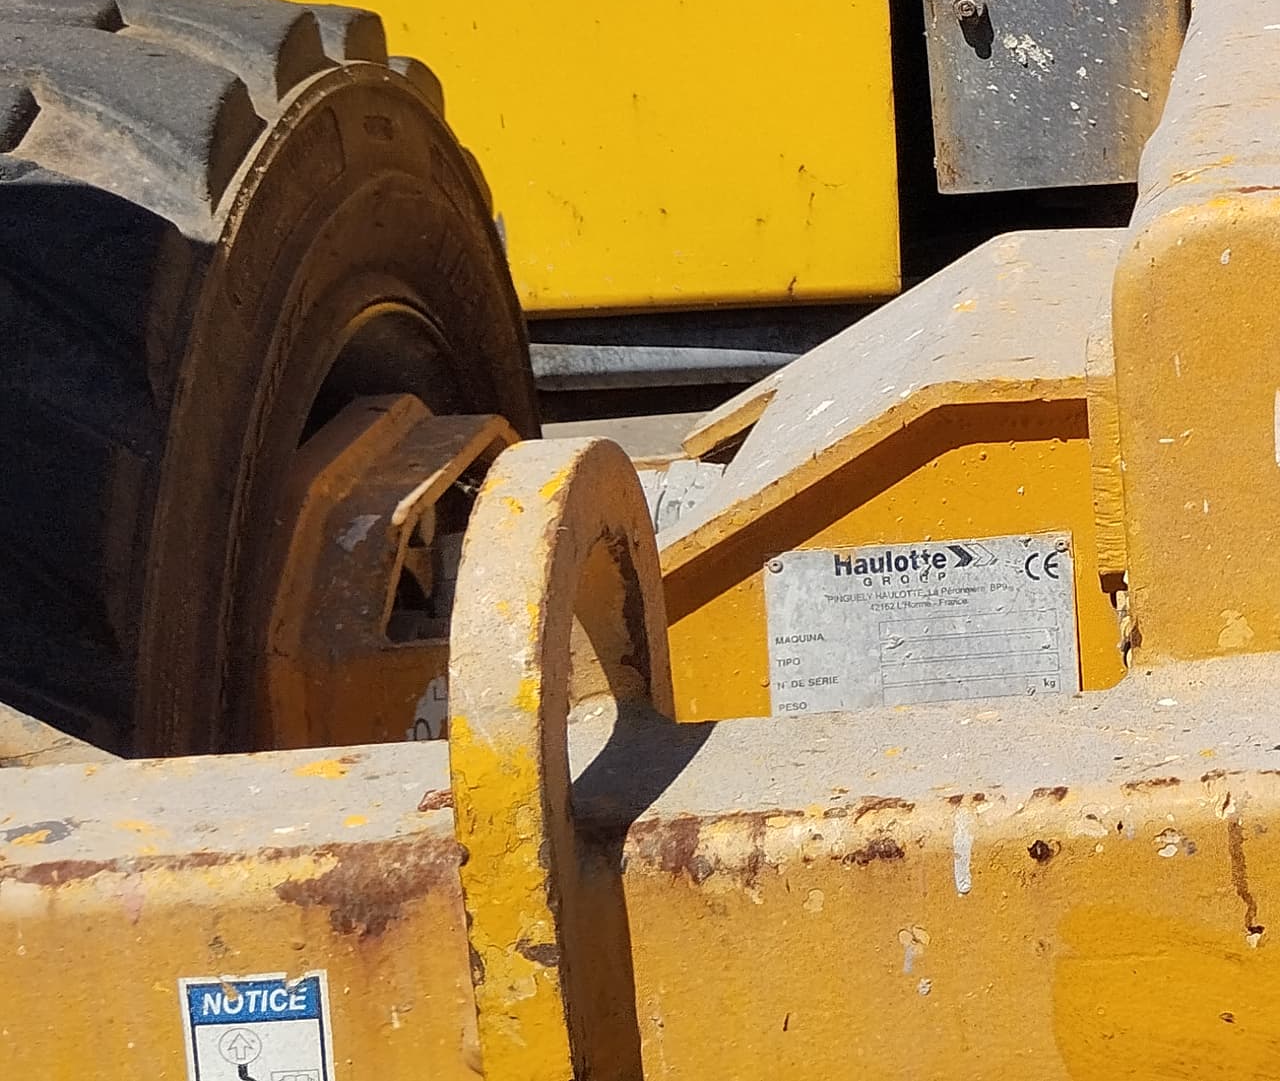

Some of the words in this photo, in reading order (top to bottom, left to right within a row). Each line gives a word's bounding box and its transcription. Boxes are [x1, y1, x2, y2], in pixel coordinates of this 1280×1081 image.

[834, 549, 947, 576] Haulotte
[1025, 551, 1059, 580] CE
[863, 572, 946, 587] GROUP
[776, 657, 801, 668] TIPO
[791, 680, 805, 688] DE
[1043, 678, 1056, 688] kg
[779, 701, 808, 712] PESO
[202, 987, 307, 1016] NOTICE
